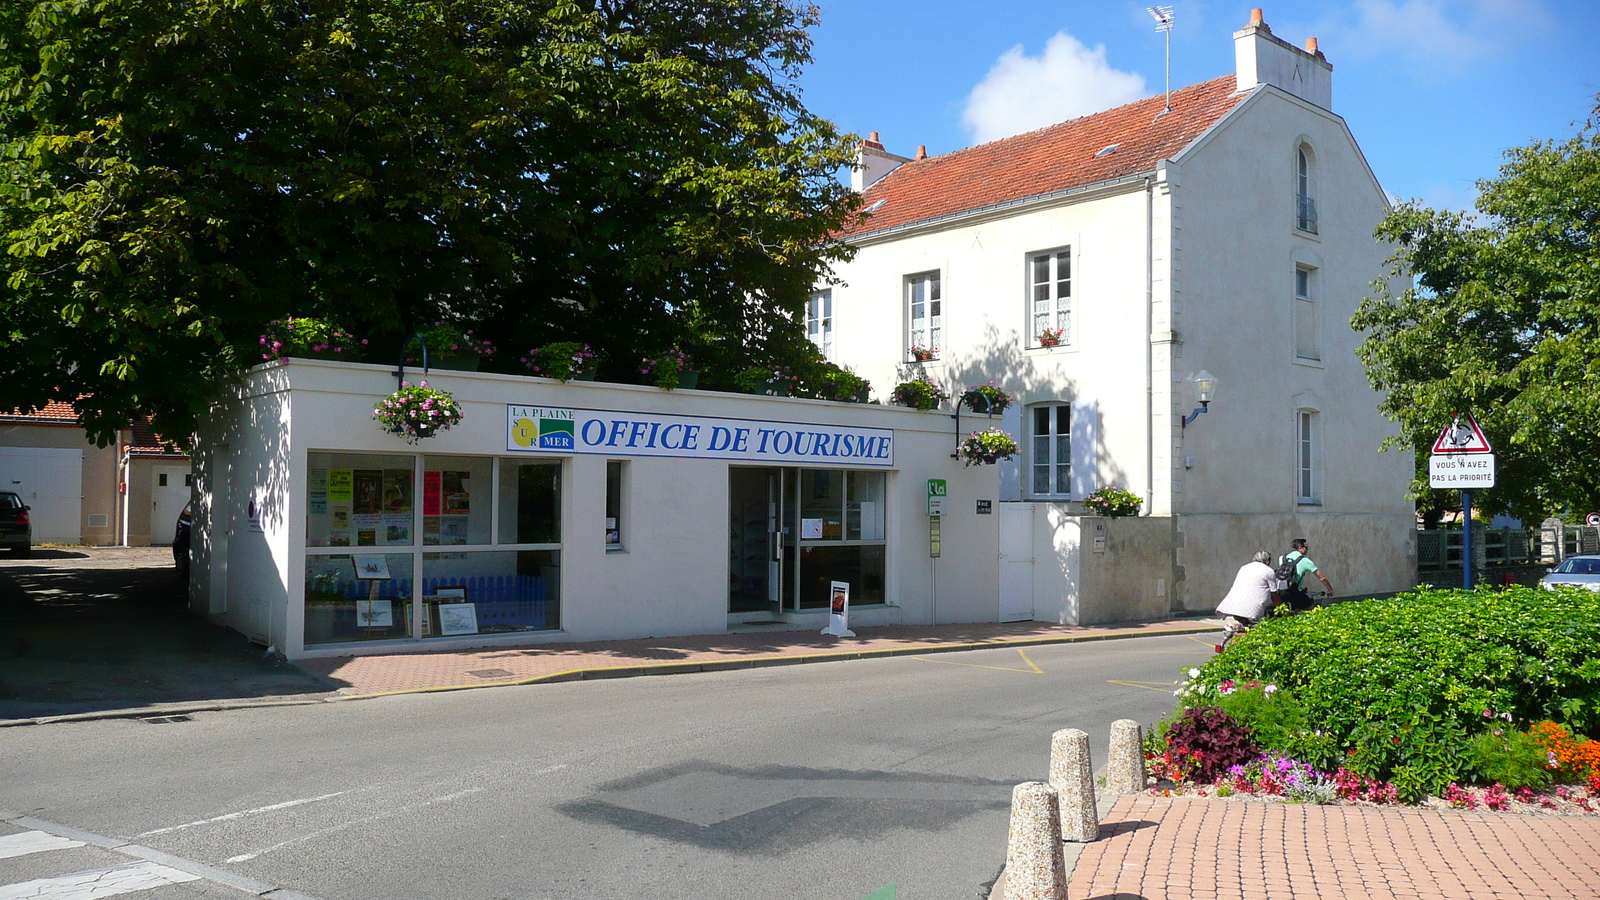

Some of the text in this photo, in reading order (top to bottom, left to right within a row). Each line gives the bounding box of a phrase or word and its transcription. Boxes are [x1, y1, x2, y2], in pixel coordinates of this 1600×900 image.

[512, 407, 575, 420] LA PLAINE
[544, 436, 570, 447] MER
[581, 418, 892, 459] OFFICE DE TOURISME
[1460, 472, 1492, 481] PRIORITÉ
